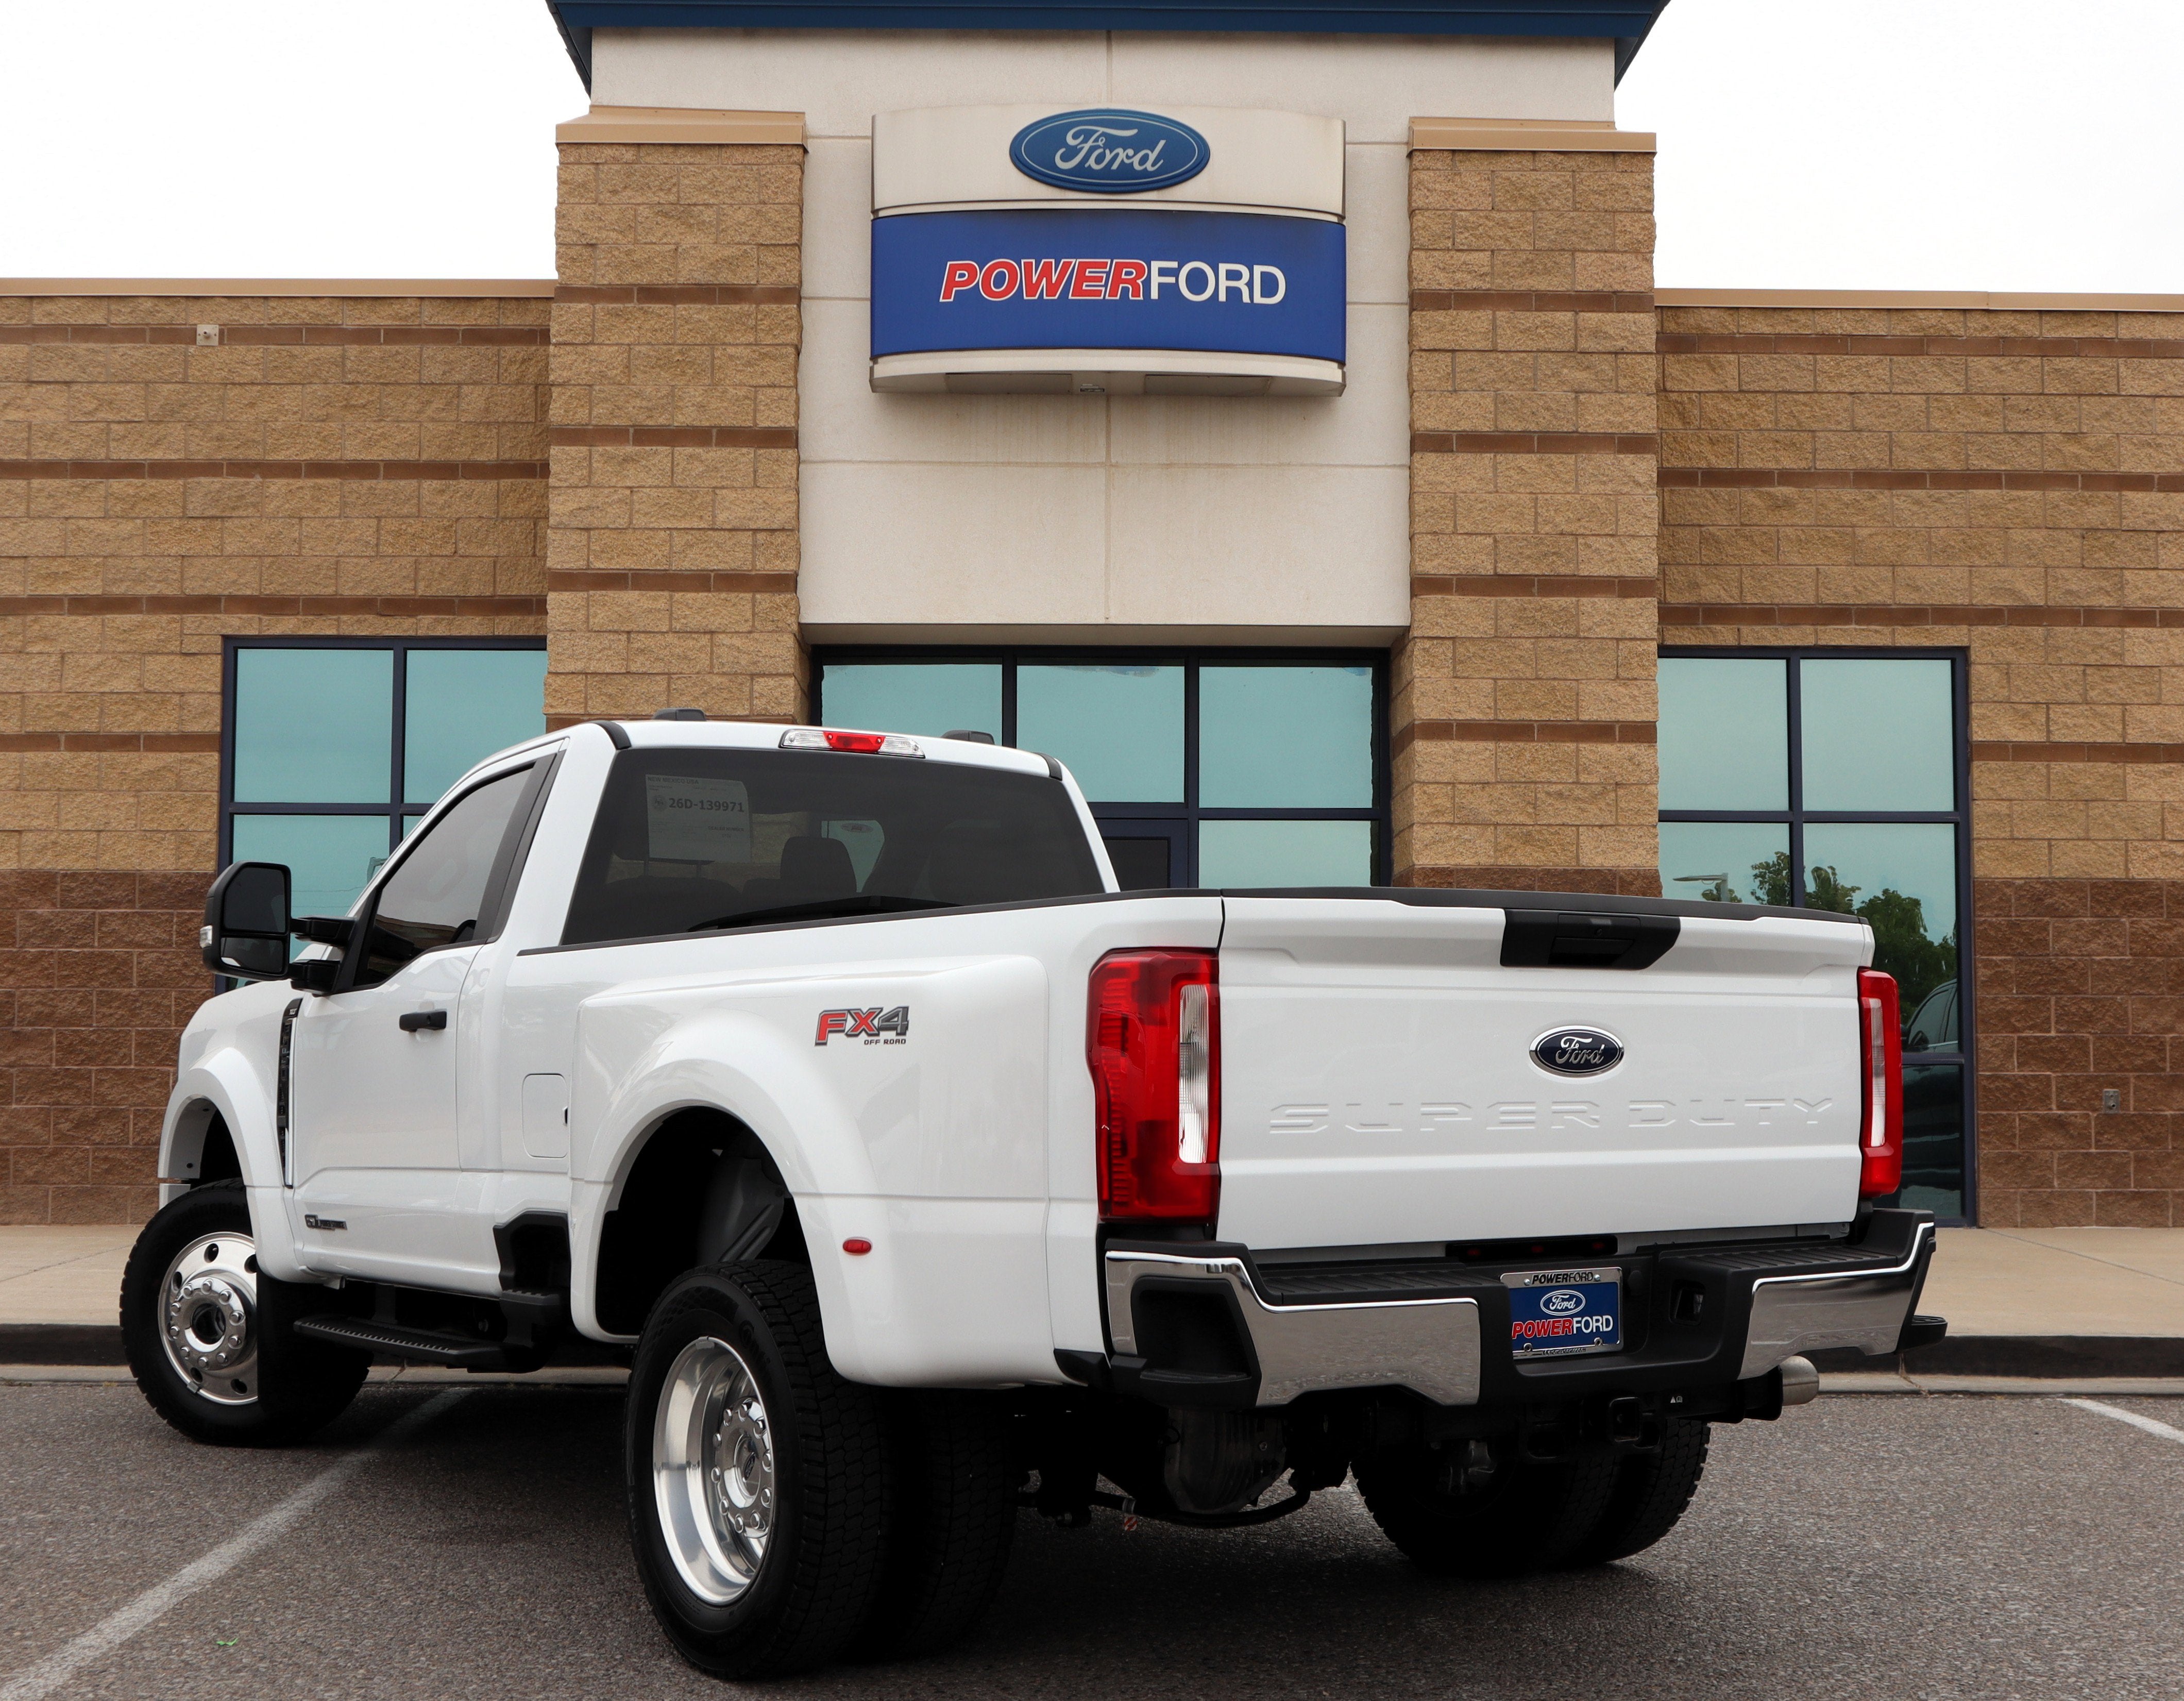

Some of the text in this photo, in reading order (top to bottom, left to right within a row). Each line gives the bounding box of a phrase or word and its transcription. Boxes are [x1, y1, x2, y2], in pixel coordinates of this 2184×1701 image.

[1054, 125, 1166, 172] Ford
[939, 258, 1286, 305] POWERFORD
[669, 798, 744, 812] 26D-139971
[815, 1006, 909, 1047] FX4
[1555, 1036, 1605, 1065] Ford
[1269, 1098, 1833, 1134] SUPER DUTY
[1532, 1272, 1594, 1285] POWERFORD
[1550, 1294, 1577, 1310] Ford
[1512, 1315, 1613, 1339] POWERFORD
